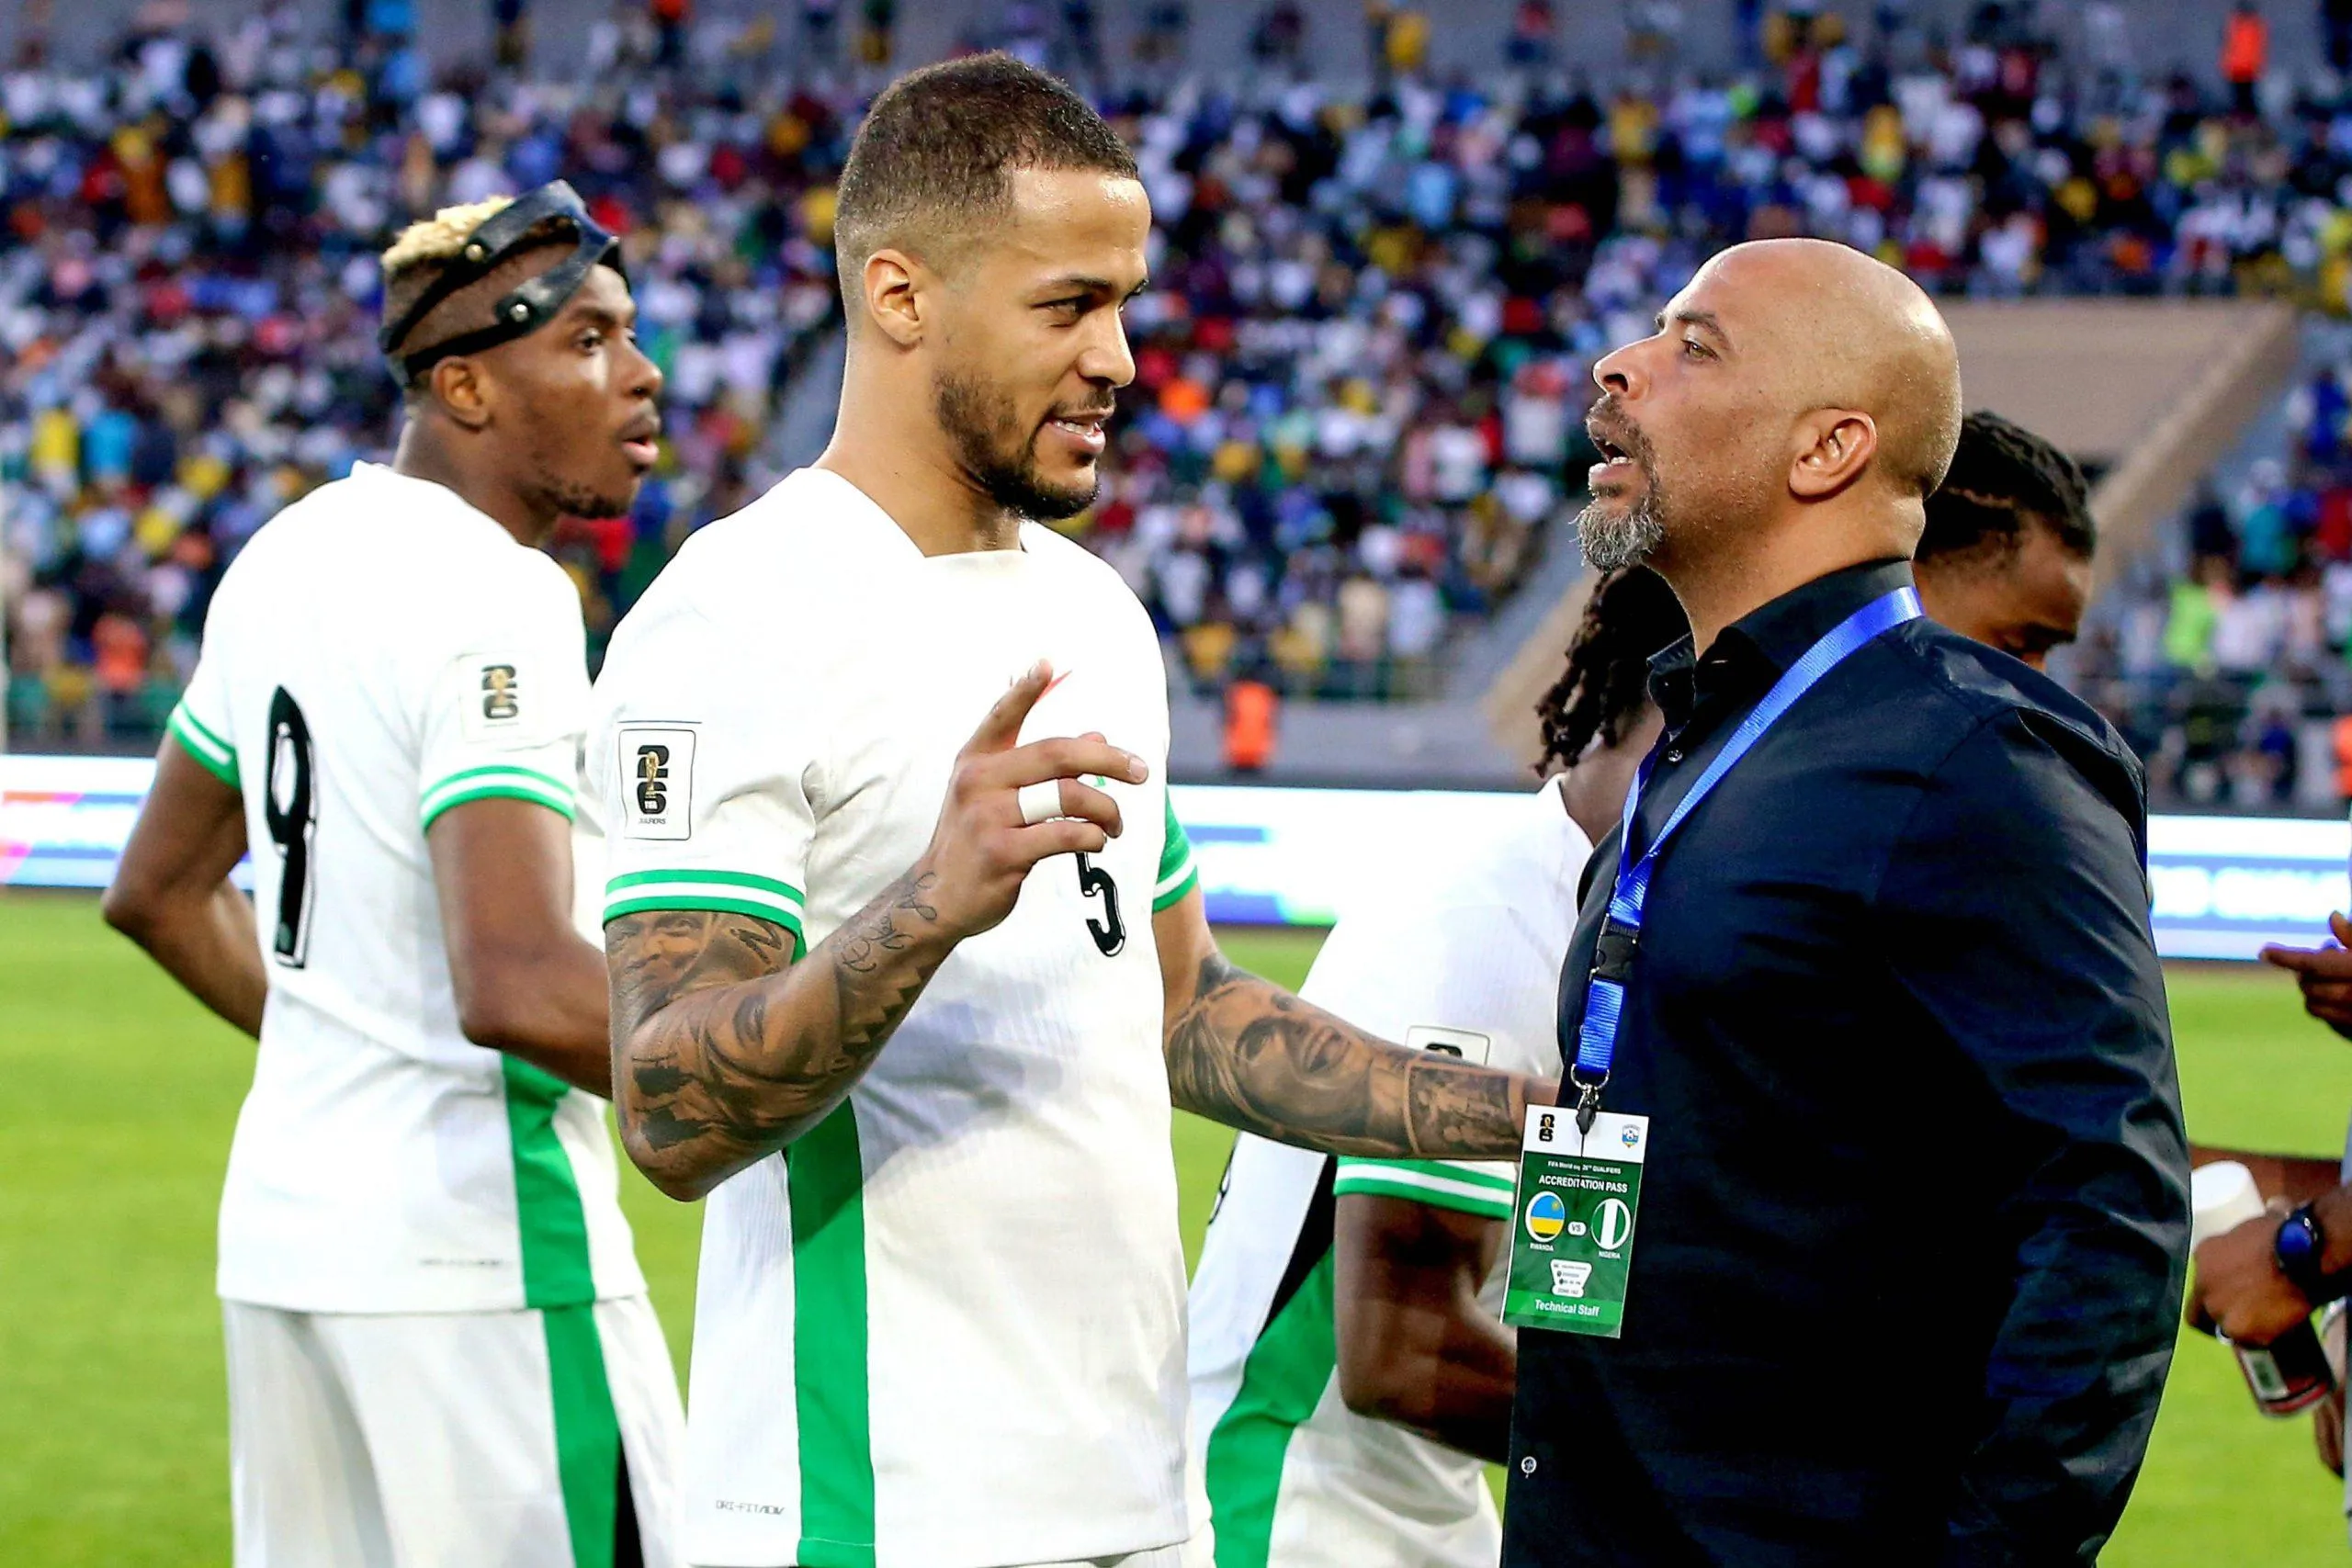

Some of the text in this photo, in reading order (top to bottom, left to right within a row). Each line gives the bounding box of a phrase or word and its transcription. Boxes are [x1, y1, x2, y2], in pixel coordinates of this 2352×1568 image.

[265, 685, 316, 969] 9
[1075, 851, 1126, 957] 5
[1538, 1175, 1628, 1193] ACCREDITATION PASS
[1571, 1223, 1581, 1232] VS
[1530, 1242, 1555, 1252] RWANDA
[1599, 1250, 1622, 1260] NIGERIA
[1534, 1299, 1600, 1316] Technical Staff
